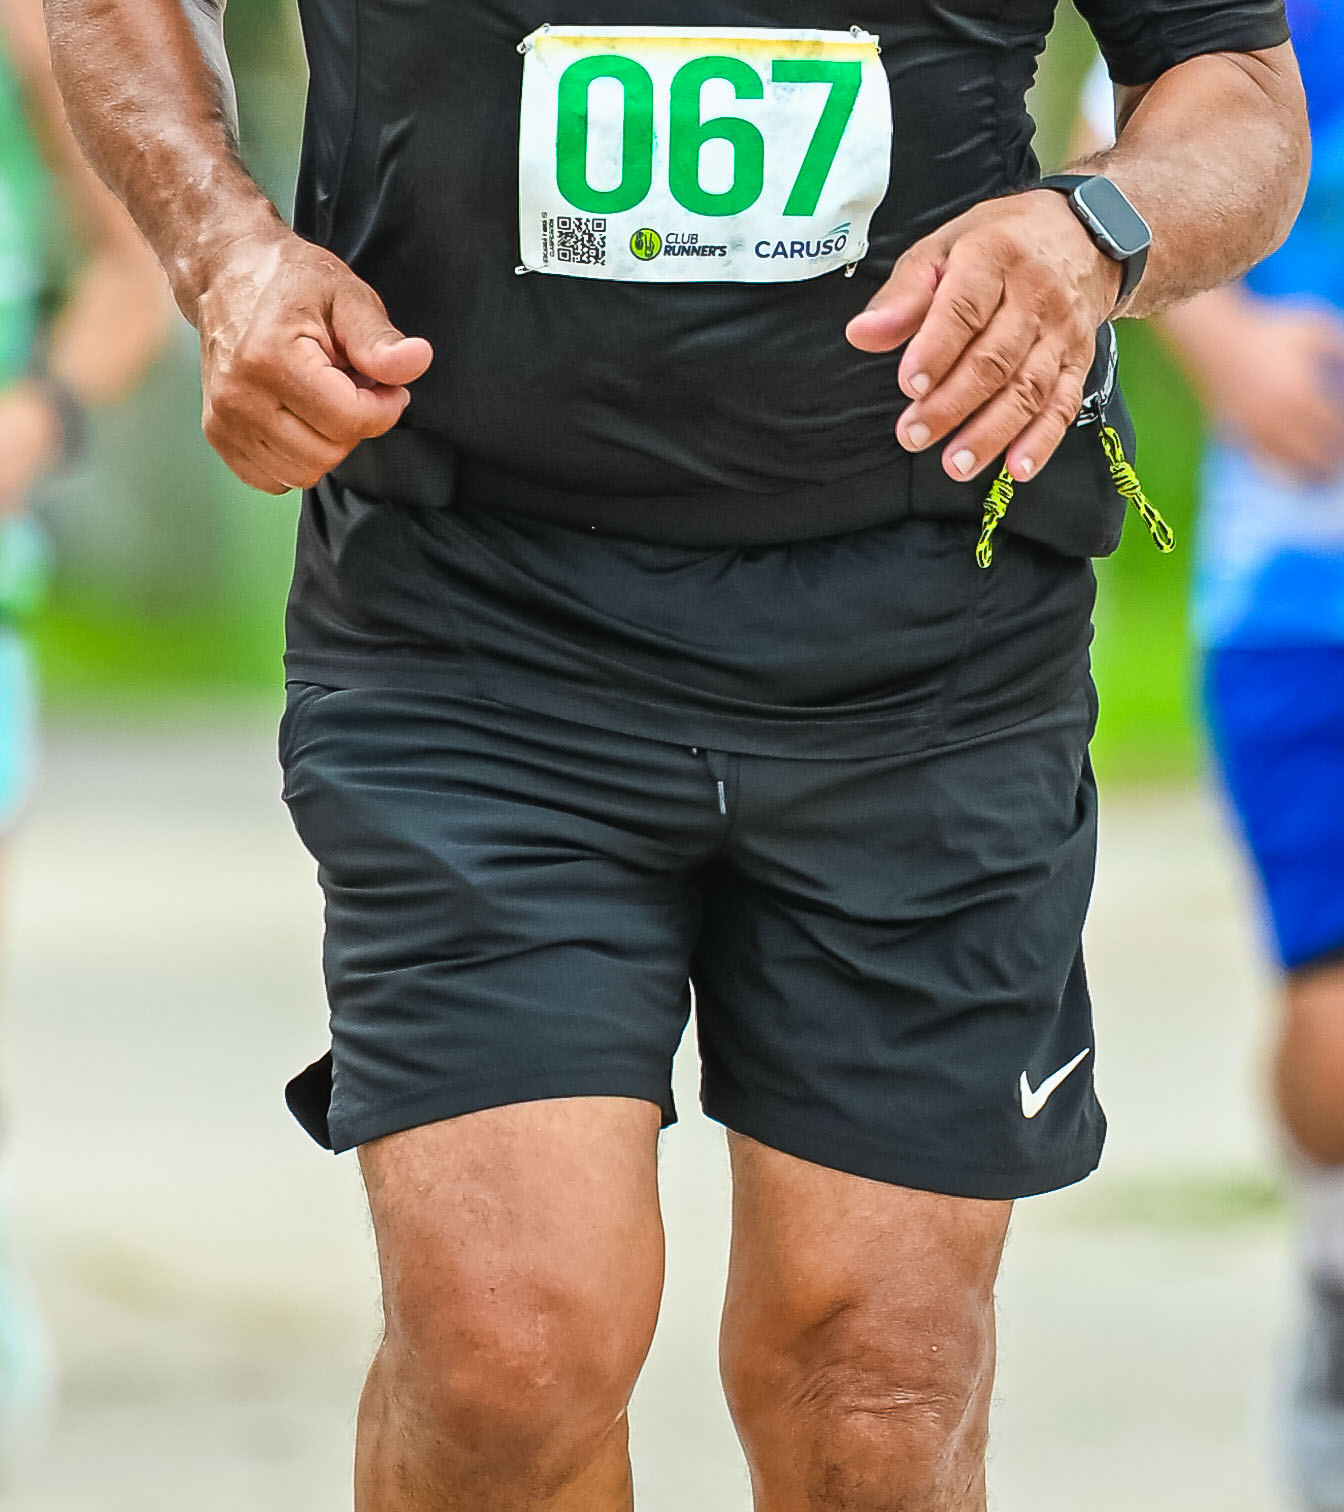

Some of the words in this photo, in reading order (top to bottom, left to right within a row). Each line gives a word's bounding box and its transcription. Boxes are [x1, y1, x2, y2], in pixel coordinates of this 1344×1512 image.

[556, 54, 862, 216] 067
[665, 232, 699, 245] CLUB
[754, 234, 848, 259] CARUSO
[663, 244, 727, 257] RUNNER'S
